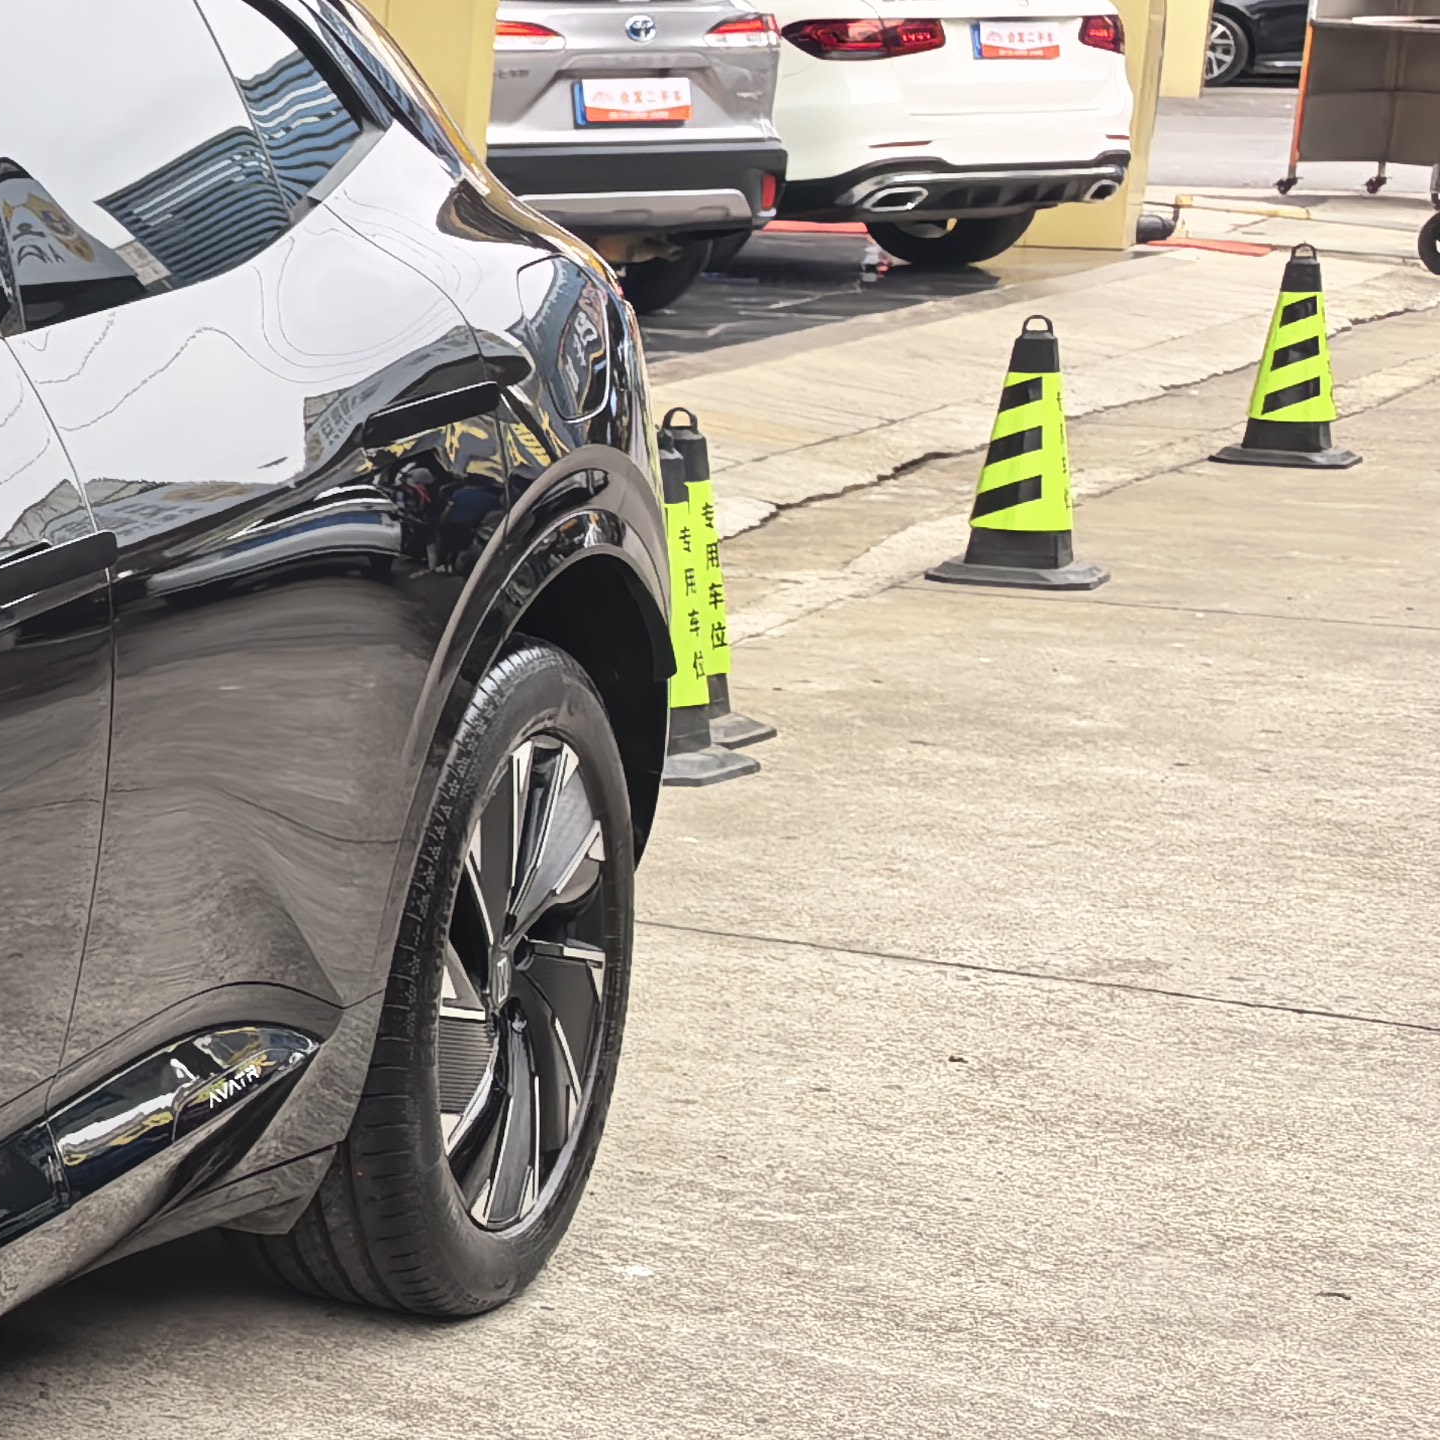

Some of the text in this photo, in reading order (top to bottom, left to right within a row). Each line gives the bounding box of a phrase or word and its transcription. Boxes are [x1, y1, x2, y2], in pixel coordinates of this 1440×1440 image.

[701, 502, 729, 651] 专用车位
[209, 1064, 260, 1109] AVATR
